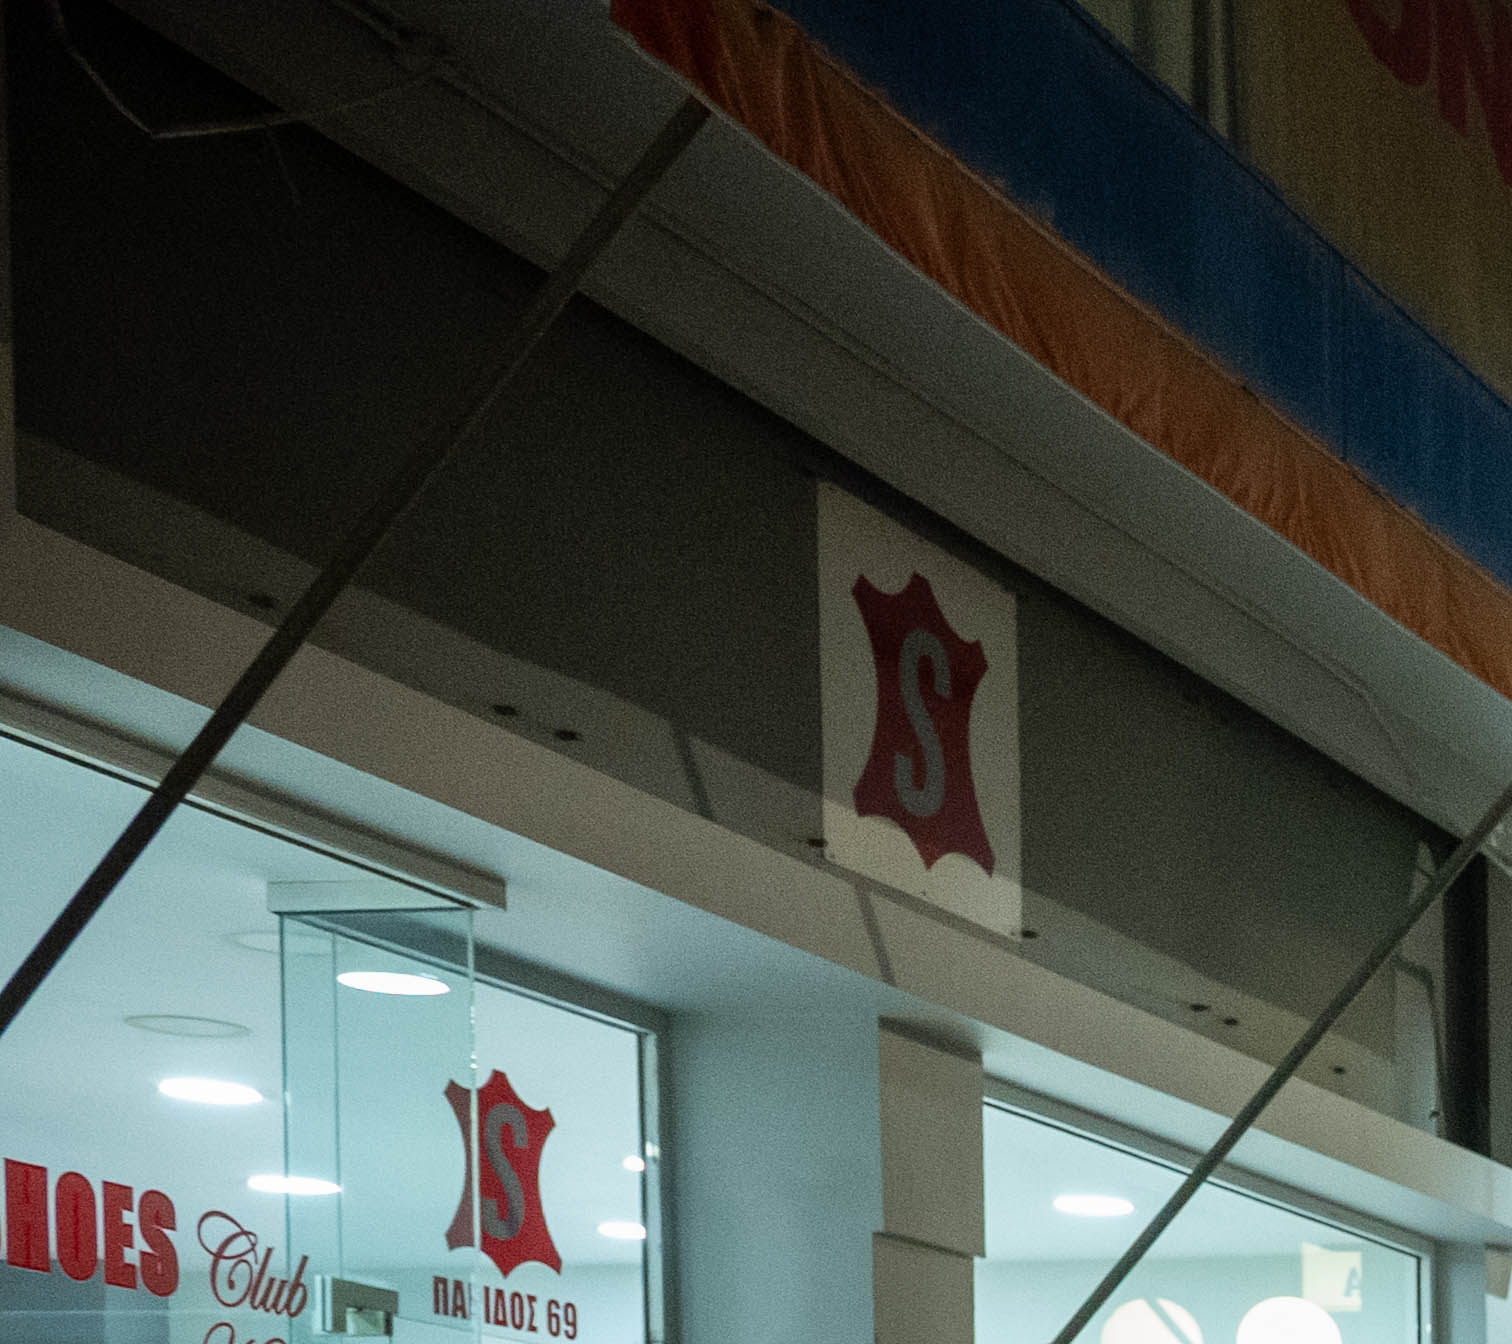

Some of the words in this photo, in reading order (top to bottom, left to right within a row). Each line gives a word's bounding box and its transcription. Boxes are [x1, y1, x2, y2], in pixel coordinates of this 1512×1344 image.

[0, 1157, 180, 1298] HOES
[196, 1210, 309, 1319] Club
[432, 1275, 538, 1334] ΠΑΙΔΟΣ
[546, 1298, 578, 1341] 69
